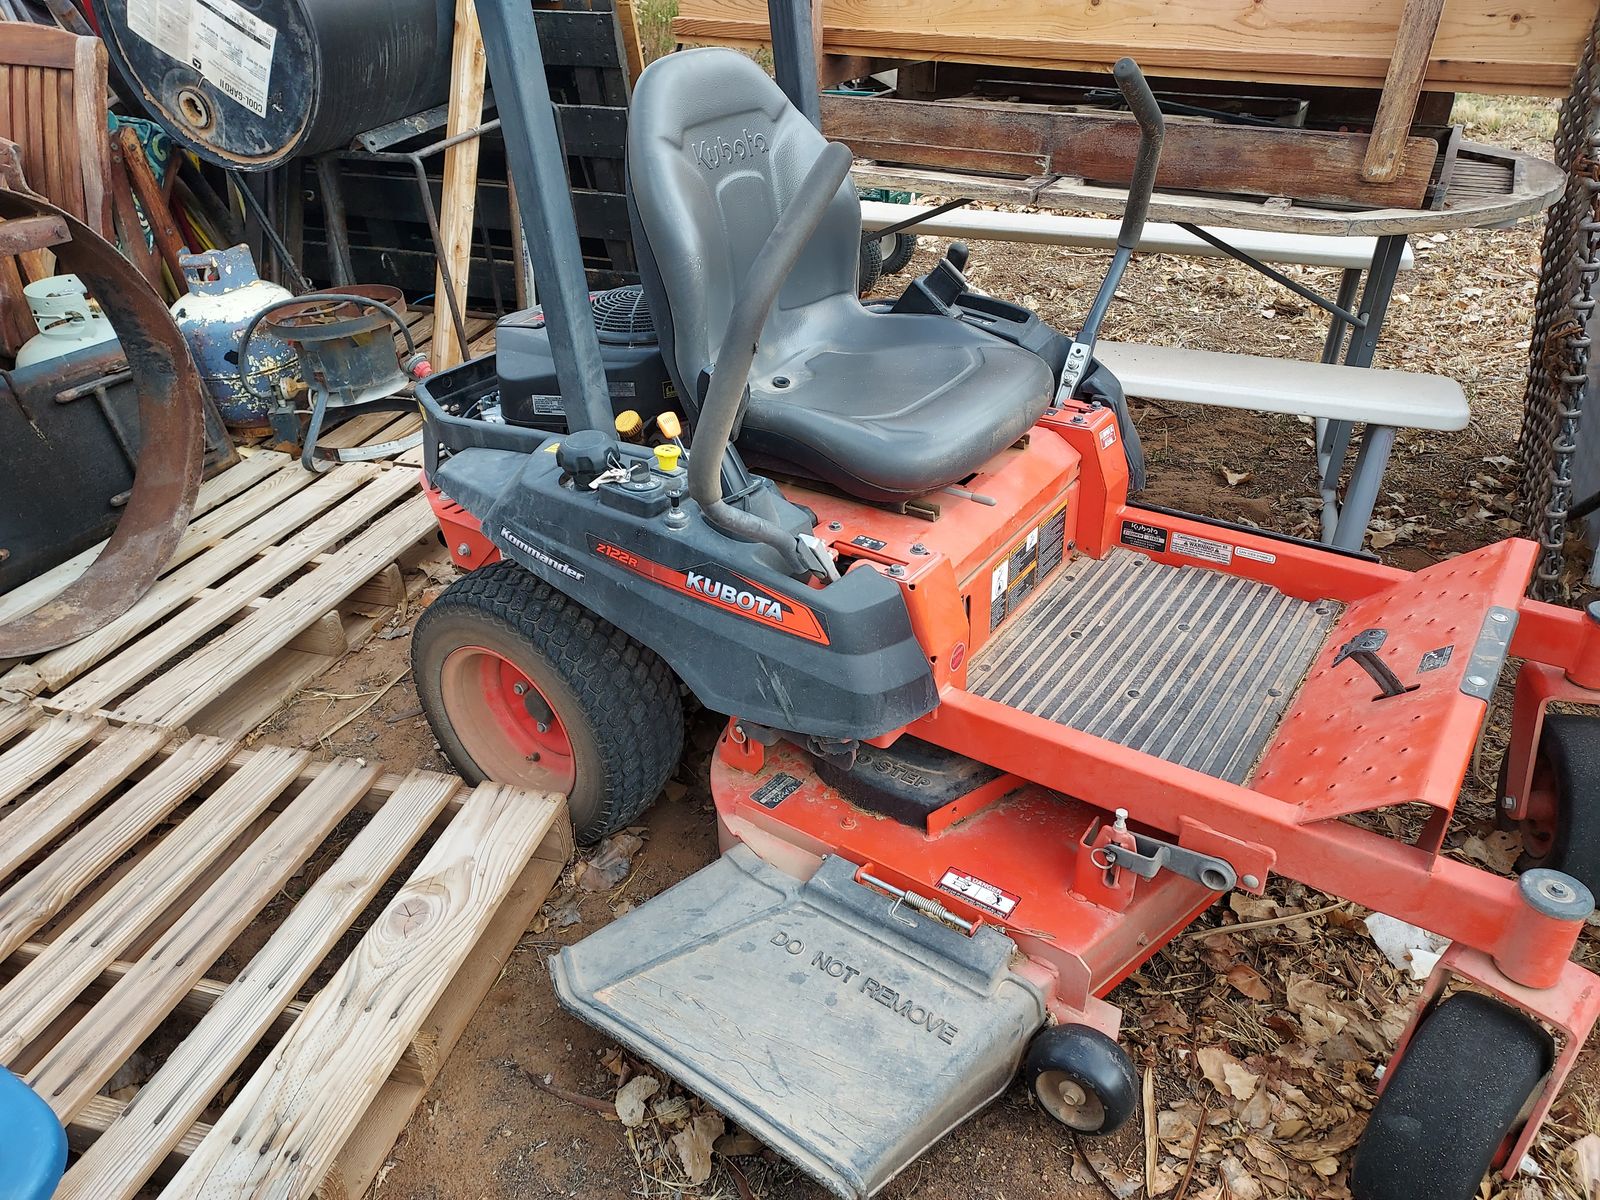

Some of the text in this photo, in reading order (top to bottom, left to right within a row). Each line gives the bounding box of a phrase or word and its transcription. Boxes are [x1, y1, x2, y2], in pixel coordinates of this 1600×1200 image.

[224, 82, 263, 113] COOL-GARD
[692, 129, 769, 170] Kubota
[1131, 522, 1158, 535] Kubota
[501, 527, 585, 582] Kommander
[1189, 541, 1215, 553] WARNING
[685, 571, 784, 622] KUBOTA
[874, 760, 932, 788] STEP
[972, 878, 1003, 896] DANGER
[770, 931, 960, 1046] DO NOT REMOVE
